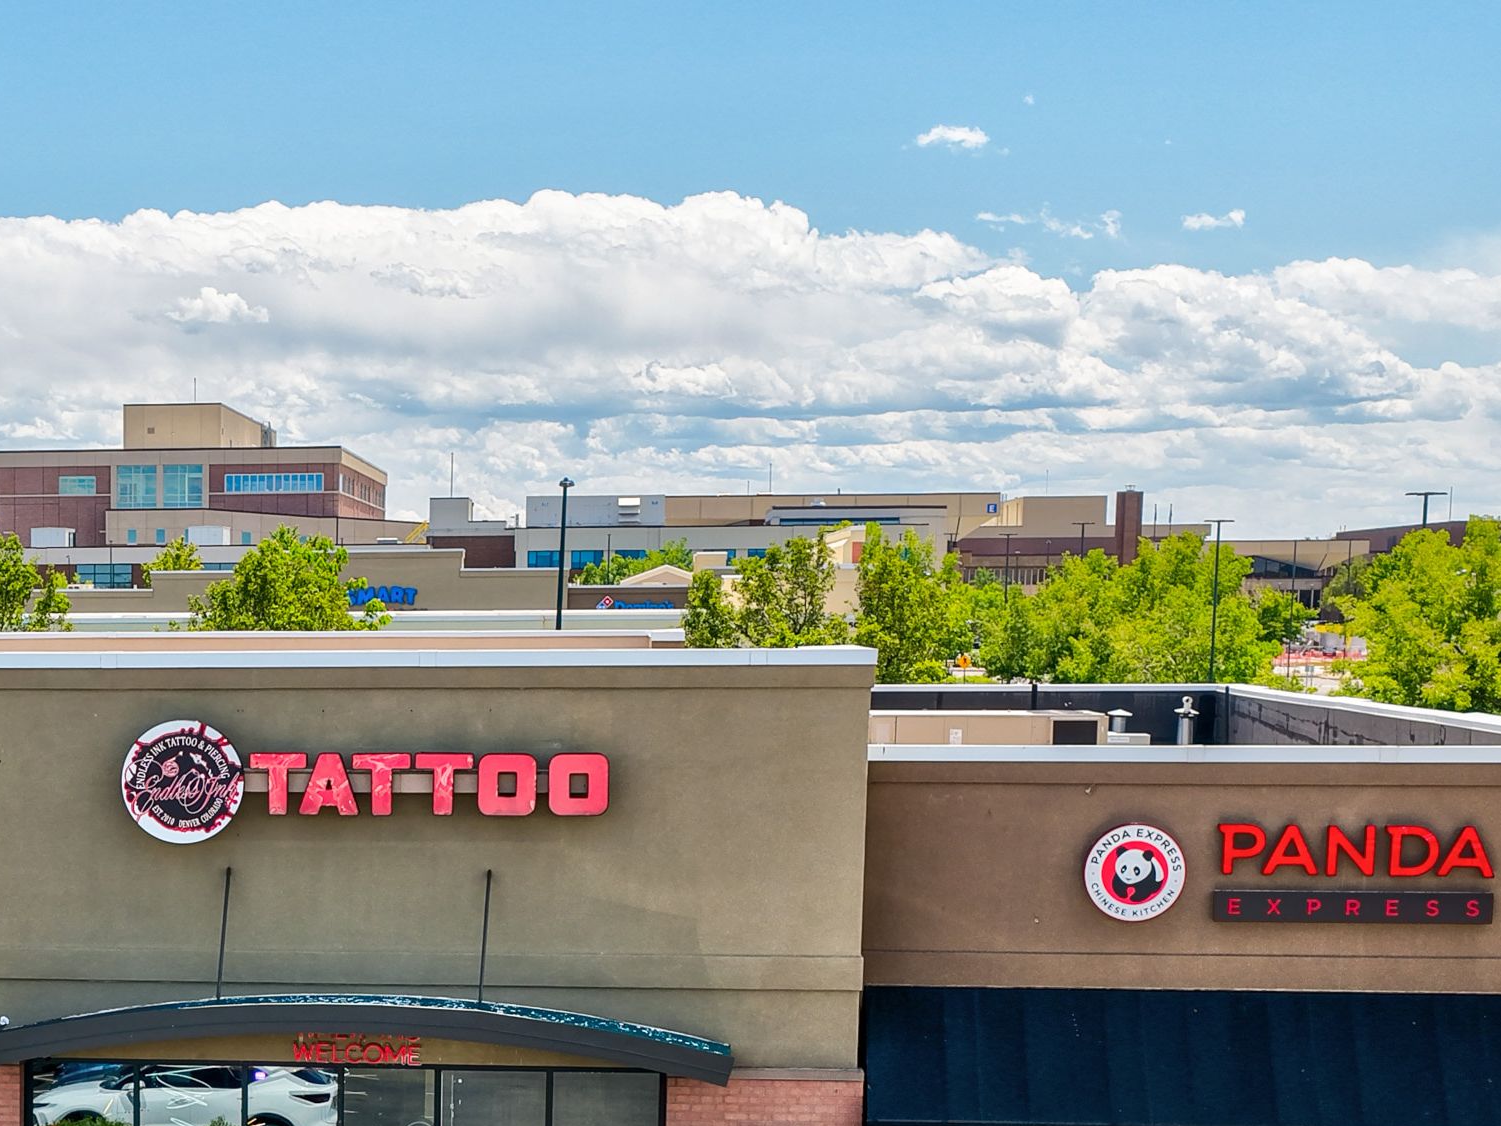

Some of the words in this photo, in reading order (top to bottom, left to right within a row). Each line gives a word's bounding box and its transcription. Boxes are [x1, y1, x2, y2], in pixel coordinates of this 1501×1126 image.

[136, 752, 155, 789] ENDLESS
[151, 742, 167, 757] INK
[166, 736, 198, 749] TATTOO
[197, 741, 205, 750] &
[204, 745, 231, 779] PIERCING
[250, 752, 610, 816] TATTOO
[178, 818, 201, 828] DENVER
[200, 797, 224, 823] COLORADO
[1091, 830, 1131, 864] PANDA
[1136, 828, 1182, 872] EXPRESS
[1217, 823, 1495, 879] PANDA
[1091, 882, 1127, 916] CHINESE
[1132, 889, 1175, 916] KITCHEN
[1227, 898, 1481, 917] EXPRESS
[293, 1041, 422, 1066] WELCOME
